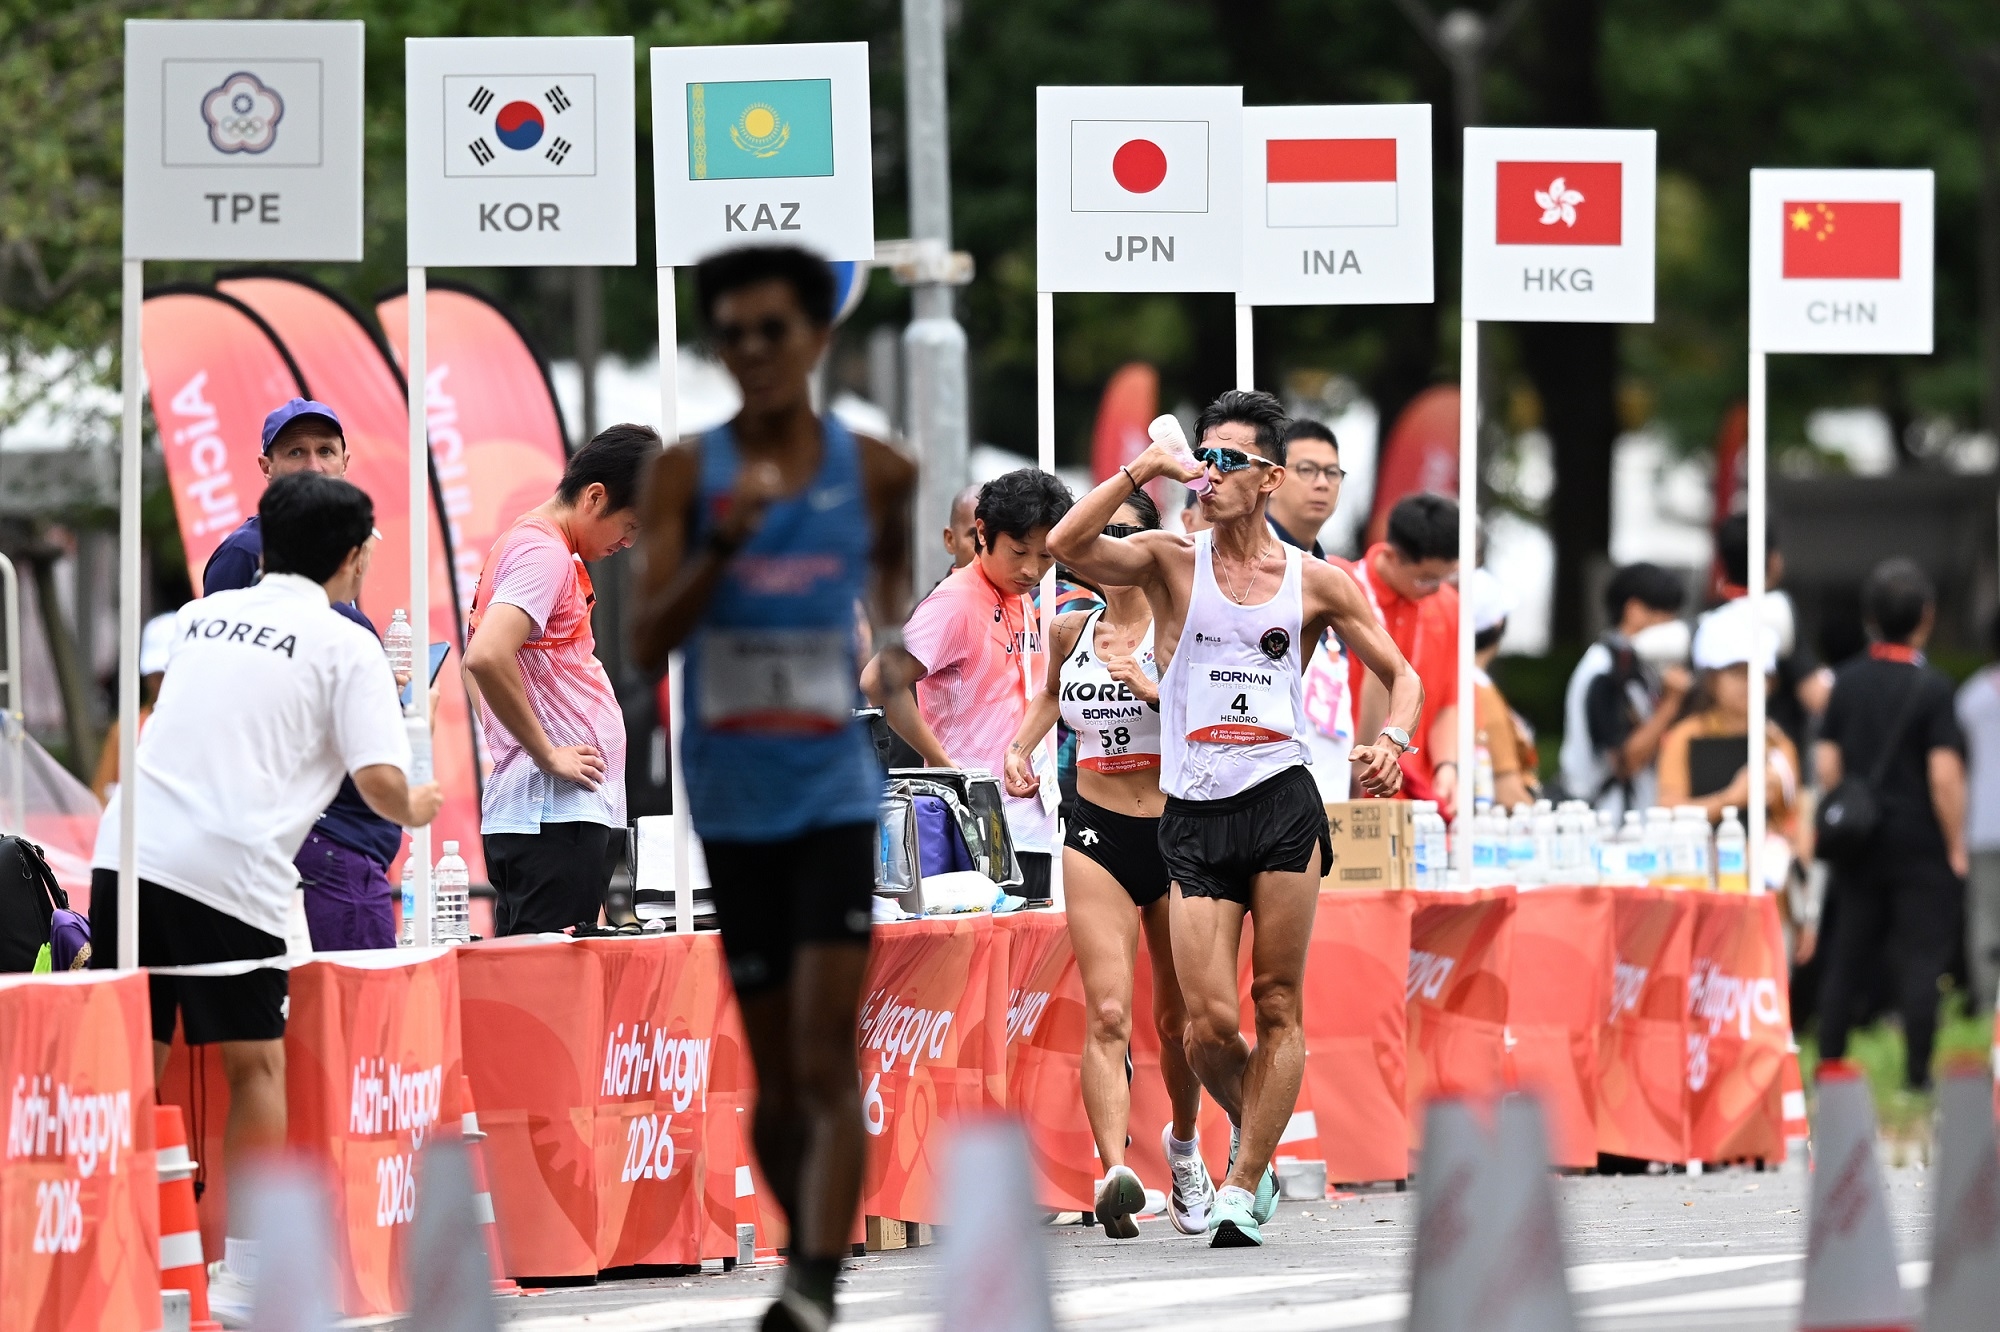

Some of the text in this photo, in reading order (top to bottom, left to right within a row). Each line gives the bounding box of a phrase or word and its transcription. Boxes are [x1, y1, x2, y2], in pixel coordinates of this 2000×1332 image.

[204, 193, 281, 225] TPE
[480, 202, 561, 232] KOR
[725, 202, 801, 232] KAZ
[1105, 235, 1175, 262] JPN
[1303, 249, 1362, 275] INA
[1523, 268, 1593, 292] HKG
[1808, 302, 1877, 324] CHN
[184, 618, 297, 659] KOREA
[1209, 670, 1272, 686] BORNAN
[1234, 683, 1271, 692] TECHNOLOGY
[1062, 682, 1139, 702] KORE
[1082, 705, 1142, 720] BORNAN
[1230, 693, 1249, 715] 4
[1220, 714, 1258, 724] HENDRO
[1098, 726, 1131, 748] 58
[1104, 746, 1128, 756] S.LEE
[601, 1021, 711, 1113] Aichi-Nagoy
